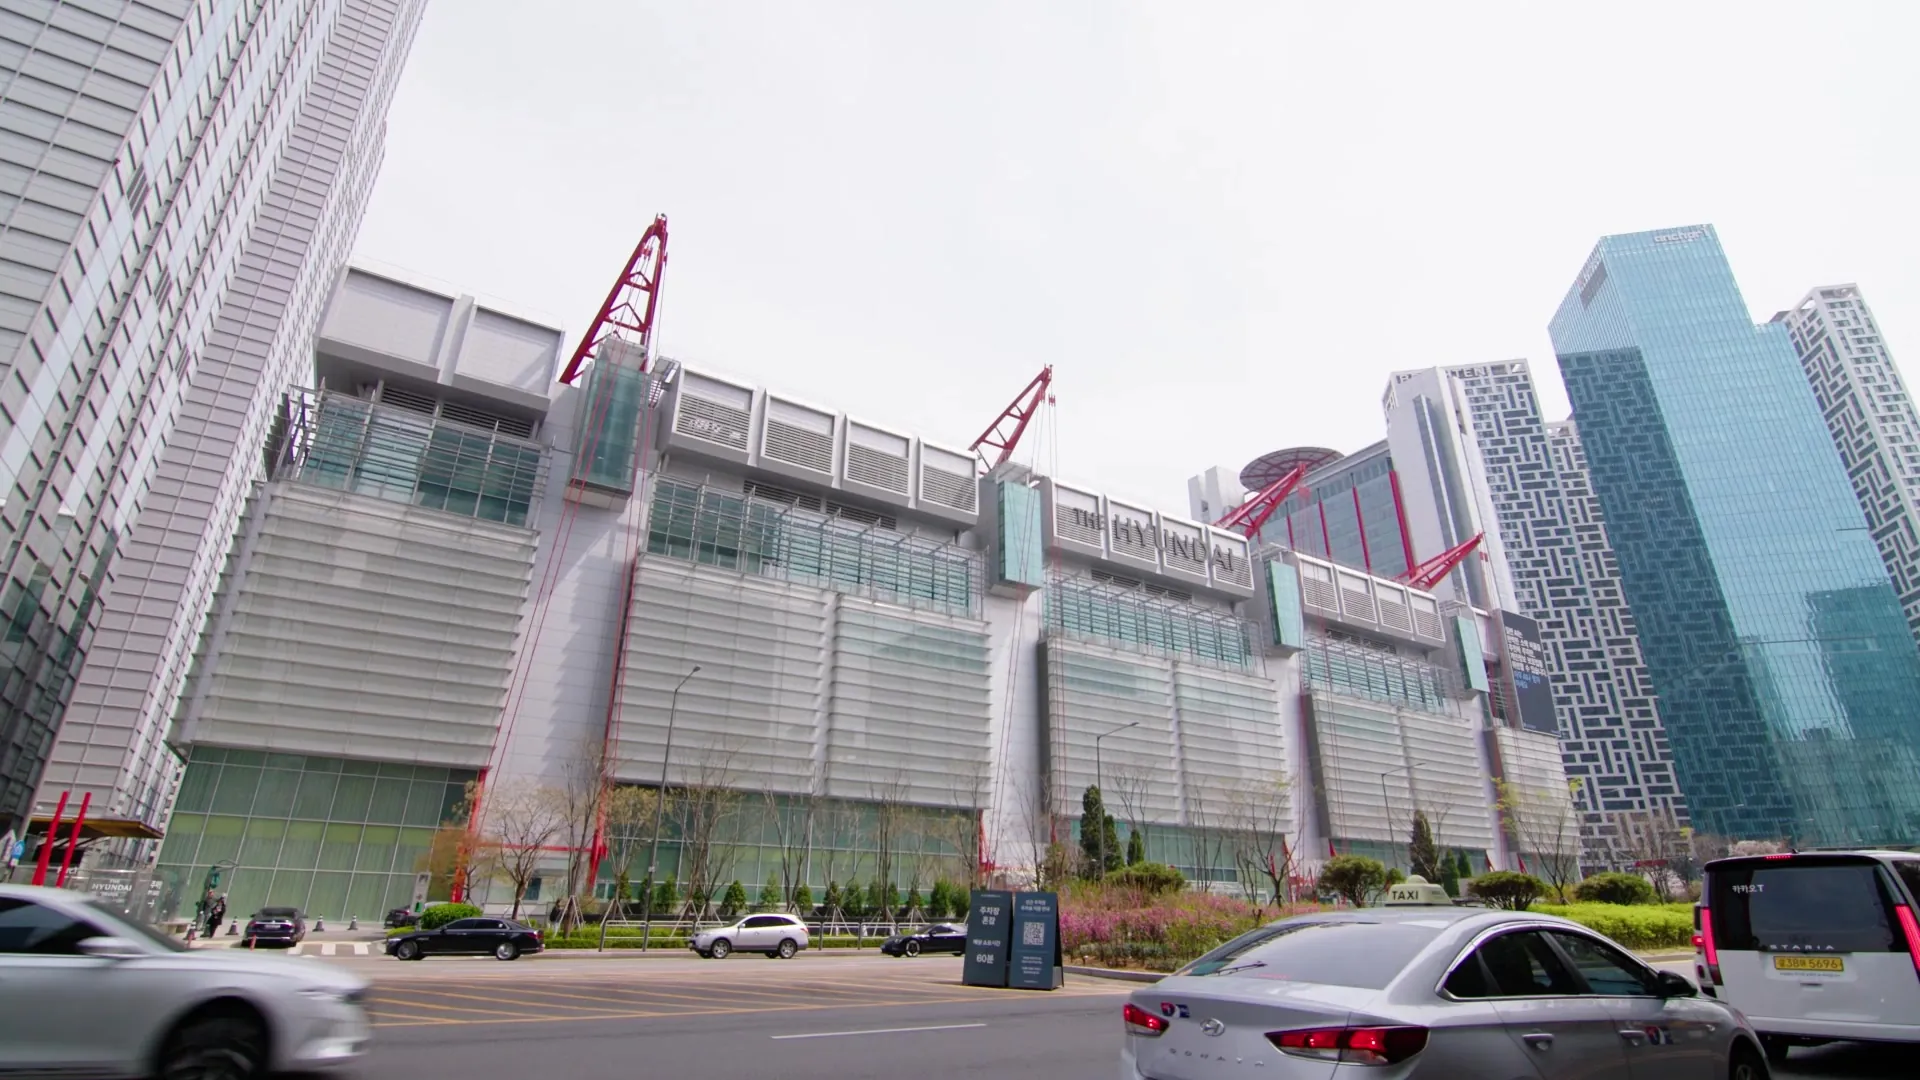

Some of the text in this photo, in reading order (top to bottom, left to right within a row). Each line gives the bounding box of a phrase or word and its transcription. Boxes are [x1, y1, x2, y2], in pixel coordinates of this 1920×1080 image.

[1073, 508, 1234, 571] THE HYUNDAI
[91, 883, 133, 892] HYUNDAI
[1392, 890, 1419, 900] TAXI
[979, 906, 1000, 916] 주차장
[981, 917, 996, 925] 혼잡
[1769, 943, 1836, 951] STARIA
[976, 954, 995, 965] 60분
[1808, 958, 1838, 969] 5696
